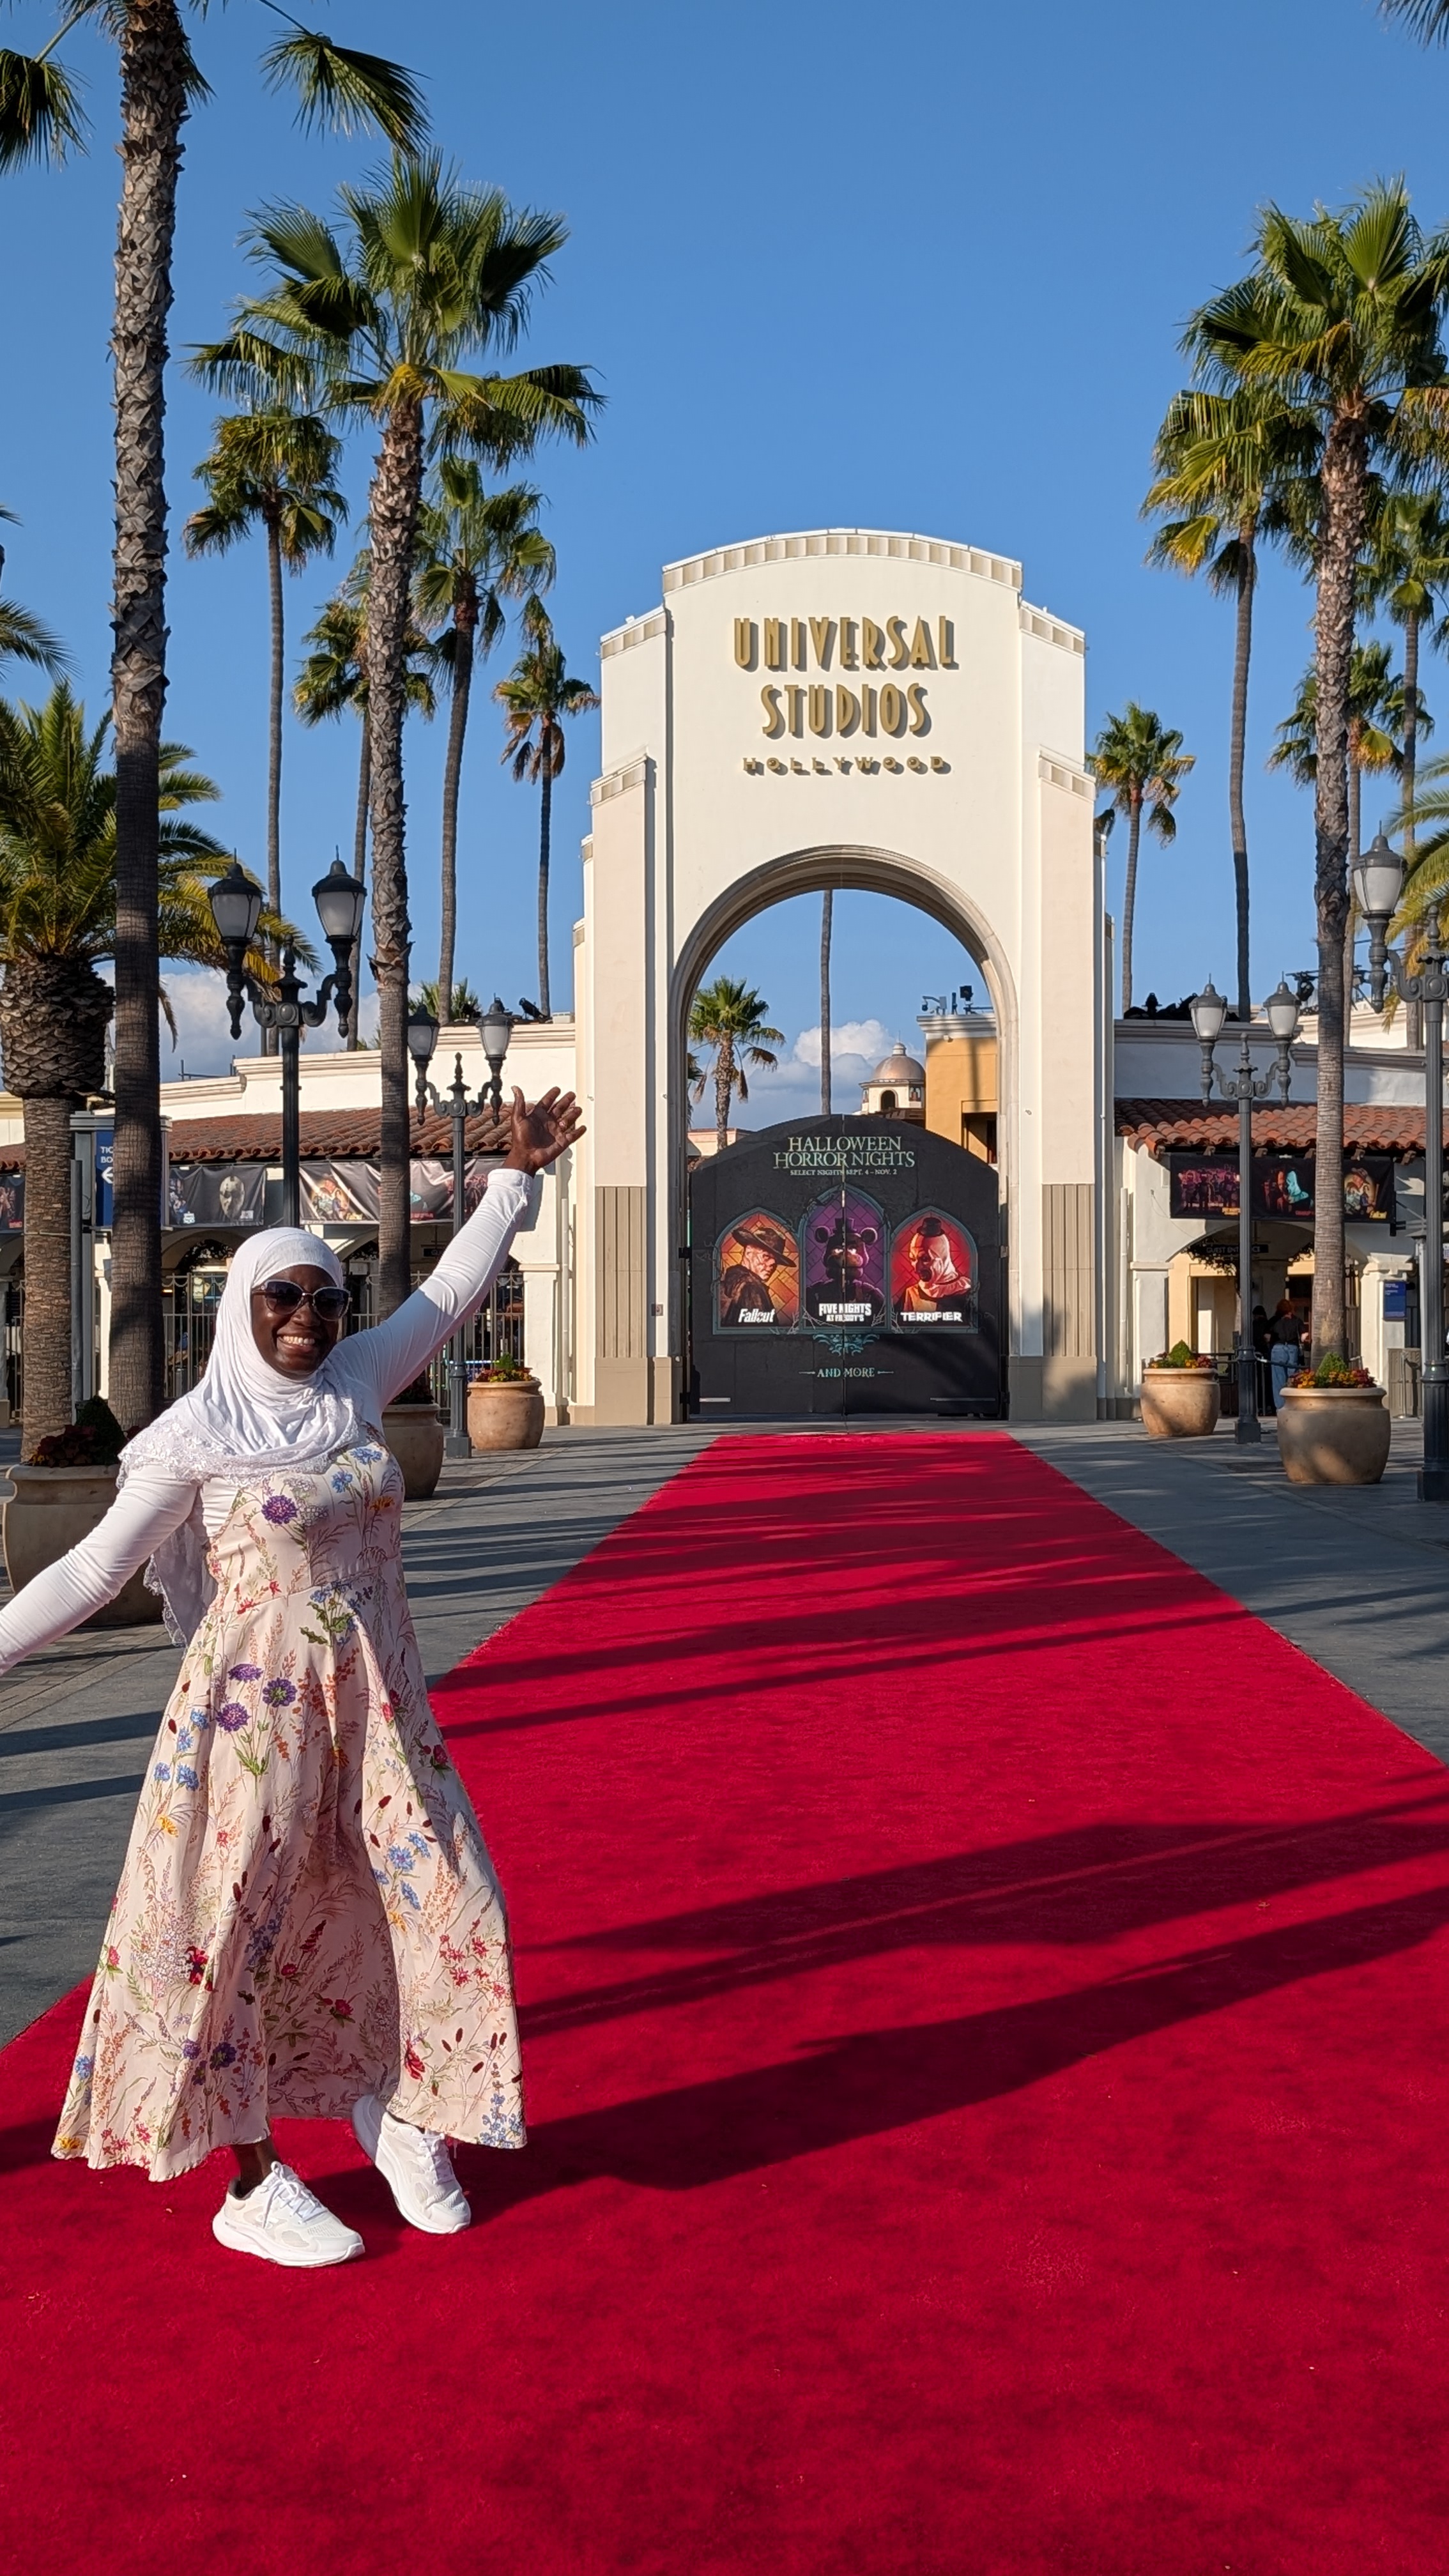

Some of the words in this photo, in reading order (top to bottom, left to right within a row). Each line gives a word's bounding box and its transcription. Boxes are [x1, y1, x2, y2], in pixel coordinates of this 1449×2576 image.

[734, 616, 954, 668] UNIVERSAL
[761, 683, 928, 736] STUDIOS
[743, 757, 947, 772] HOLLYWOOD
[788, 1136, 901, 1151] HALLOWEEN
[773, 1151, 849, 1169] HORROR
[850, 1151, 915, 1168] NIGHTS
[738, 1308, 775, 1323] Fallout
[819, 1303, 838, 1316] FIVE
[838, 1303, 871, 1316] NIGHTS
[900, 1312, 963, 1322] TERRIFIER
[817, 1368, 841, 1377] AND
[843, 1368, 875, 1377] MORE
